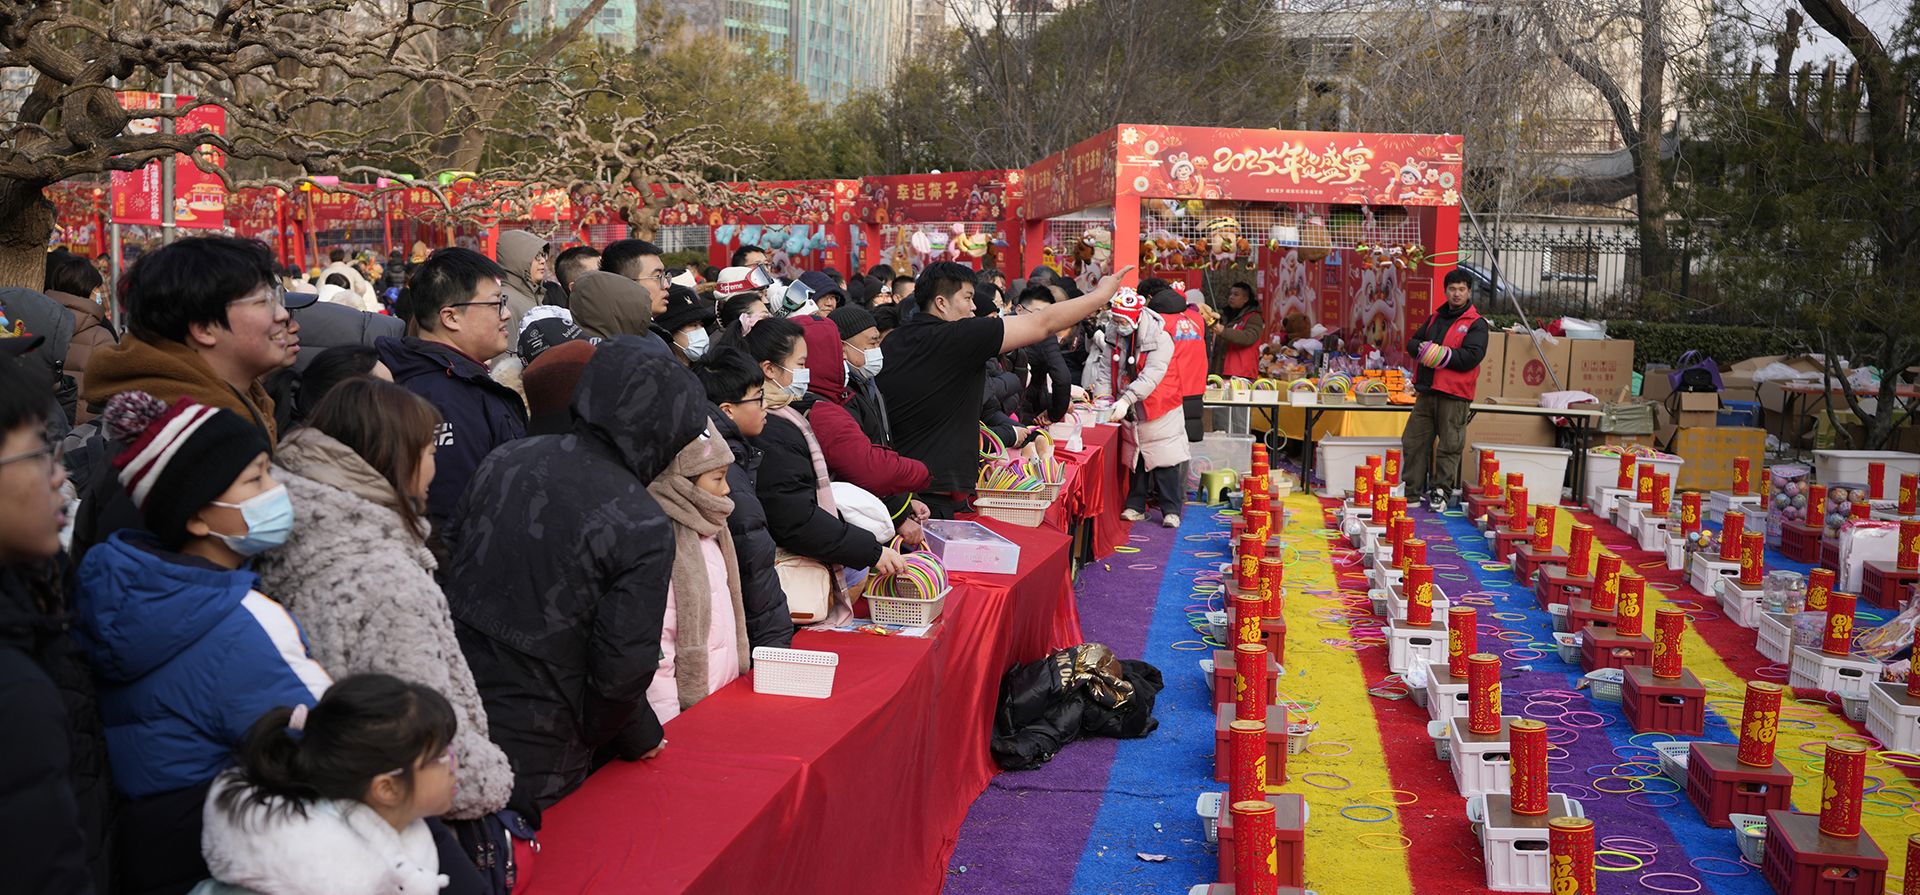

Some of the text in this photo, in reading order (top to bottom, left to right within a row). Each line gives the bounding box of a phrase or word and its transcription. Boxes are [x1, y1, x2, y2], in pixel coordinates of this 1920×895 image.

[1212, 139, 1375, 185] 2025年货盛宴
[896, 181, 959, 201] 幸运筛子
[720, 282, 743, 293] Supreme
[1618, 592, 1640, 618] 福
[1239, 616, 1262, 643] 福
[1831, 613, 1853, 639] 福
[1747, 710, 1776, 743] 福
